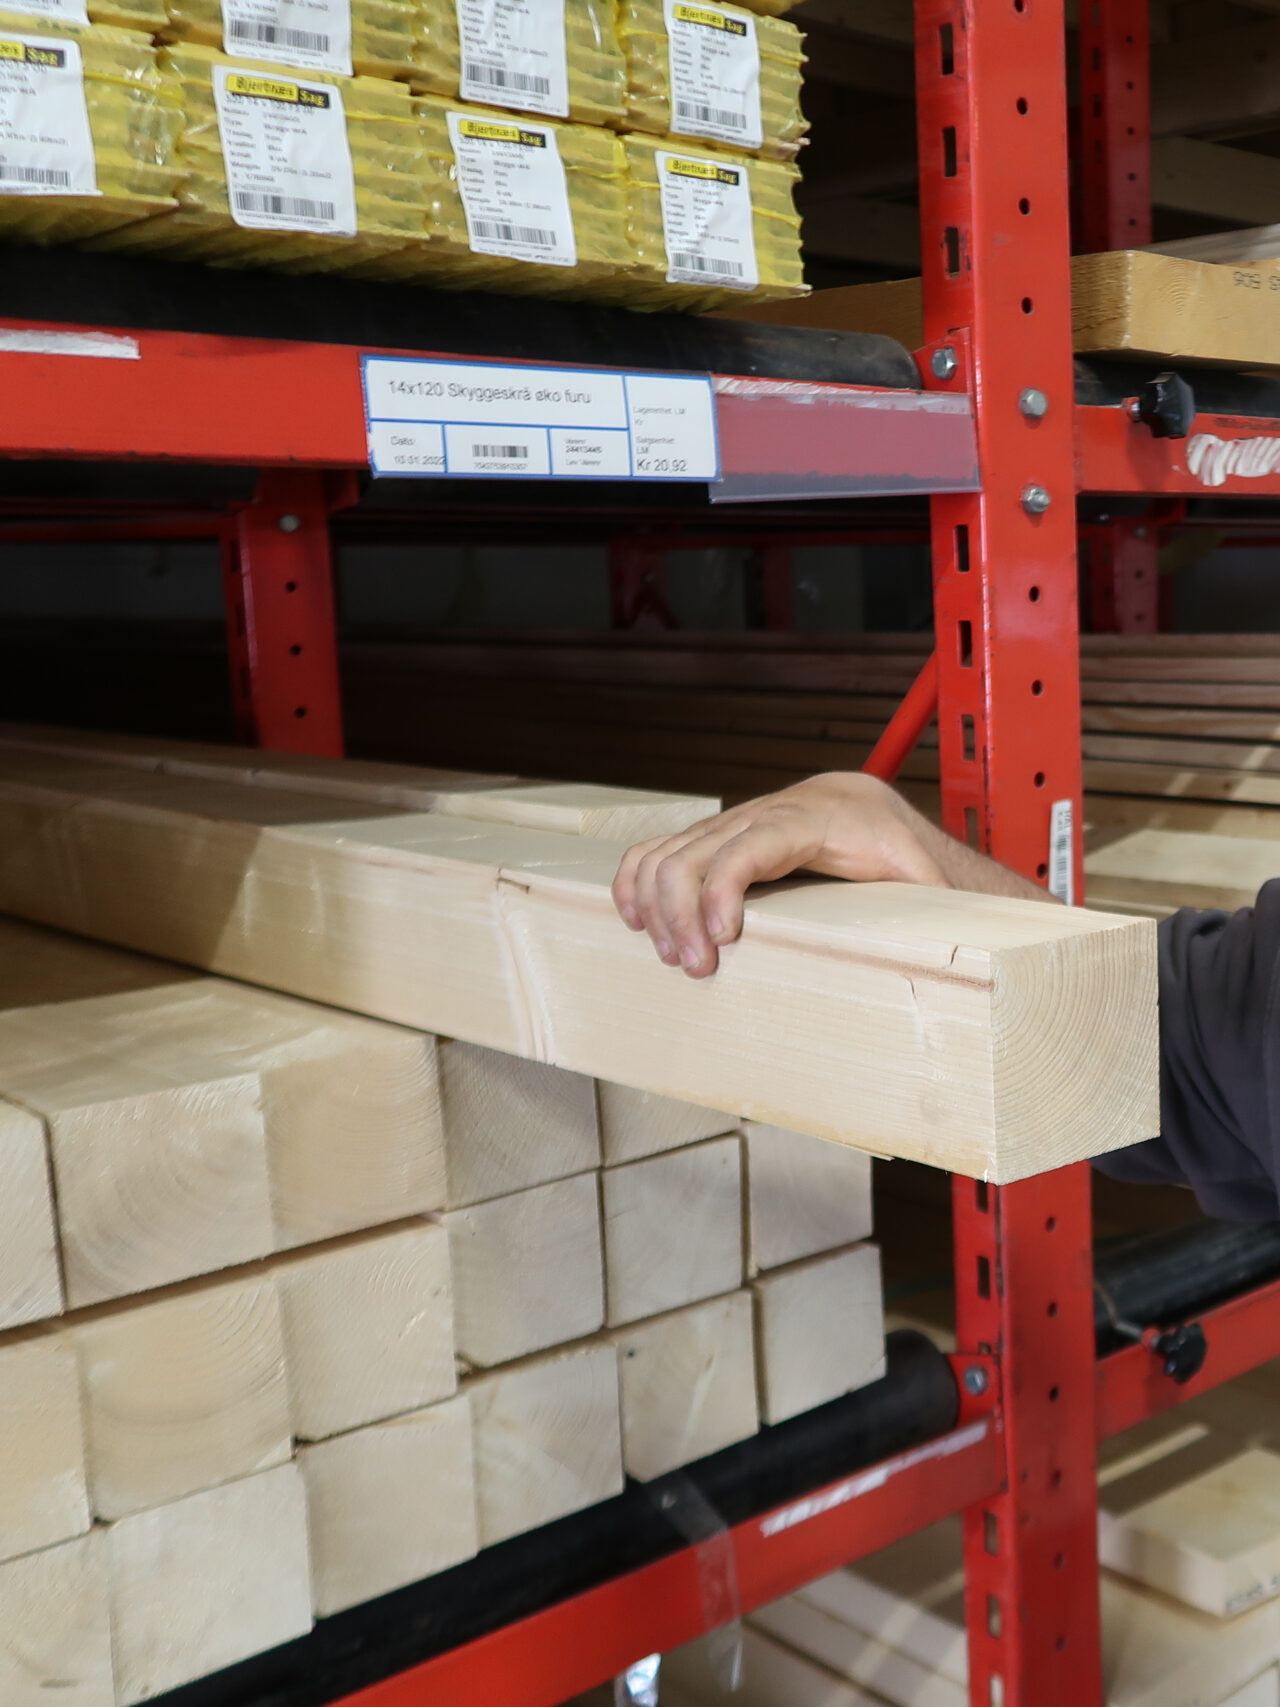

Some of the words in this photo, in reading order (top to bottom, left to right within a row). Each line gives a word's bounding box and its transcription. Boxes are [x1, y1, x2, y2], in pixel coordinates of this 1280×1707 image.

[388, 380, 445, 397] 14x120
[447, 383, 532, 403] Skyggeskrå
[564, 389, 592, 404] furu
[636, 459, 651, 471] Kr
[653, 459, 688, 473] 20,92
